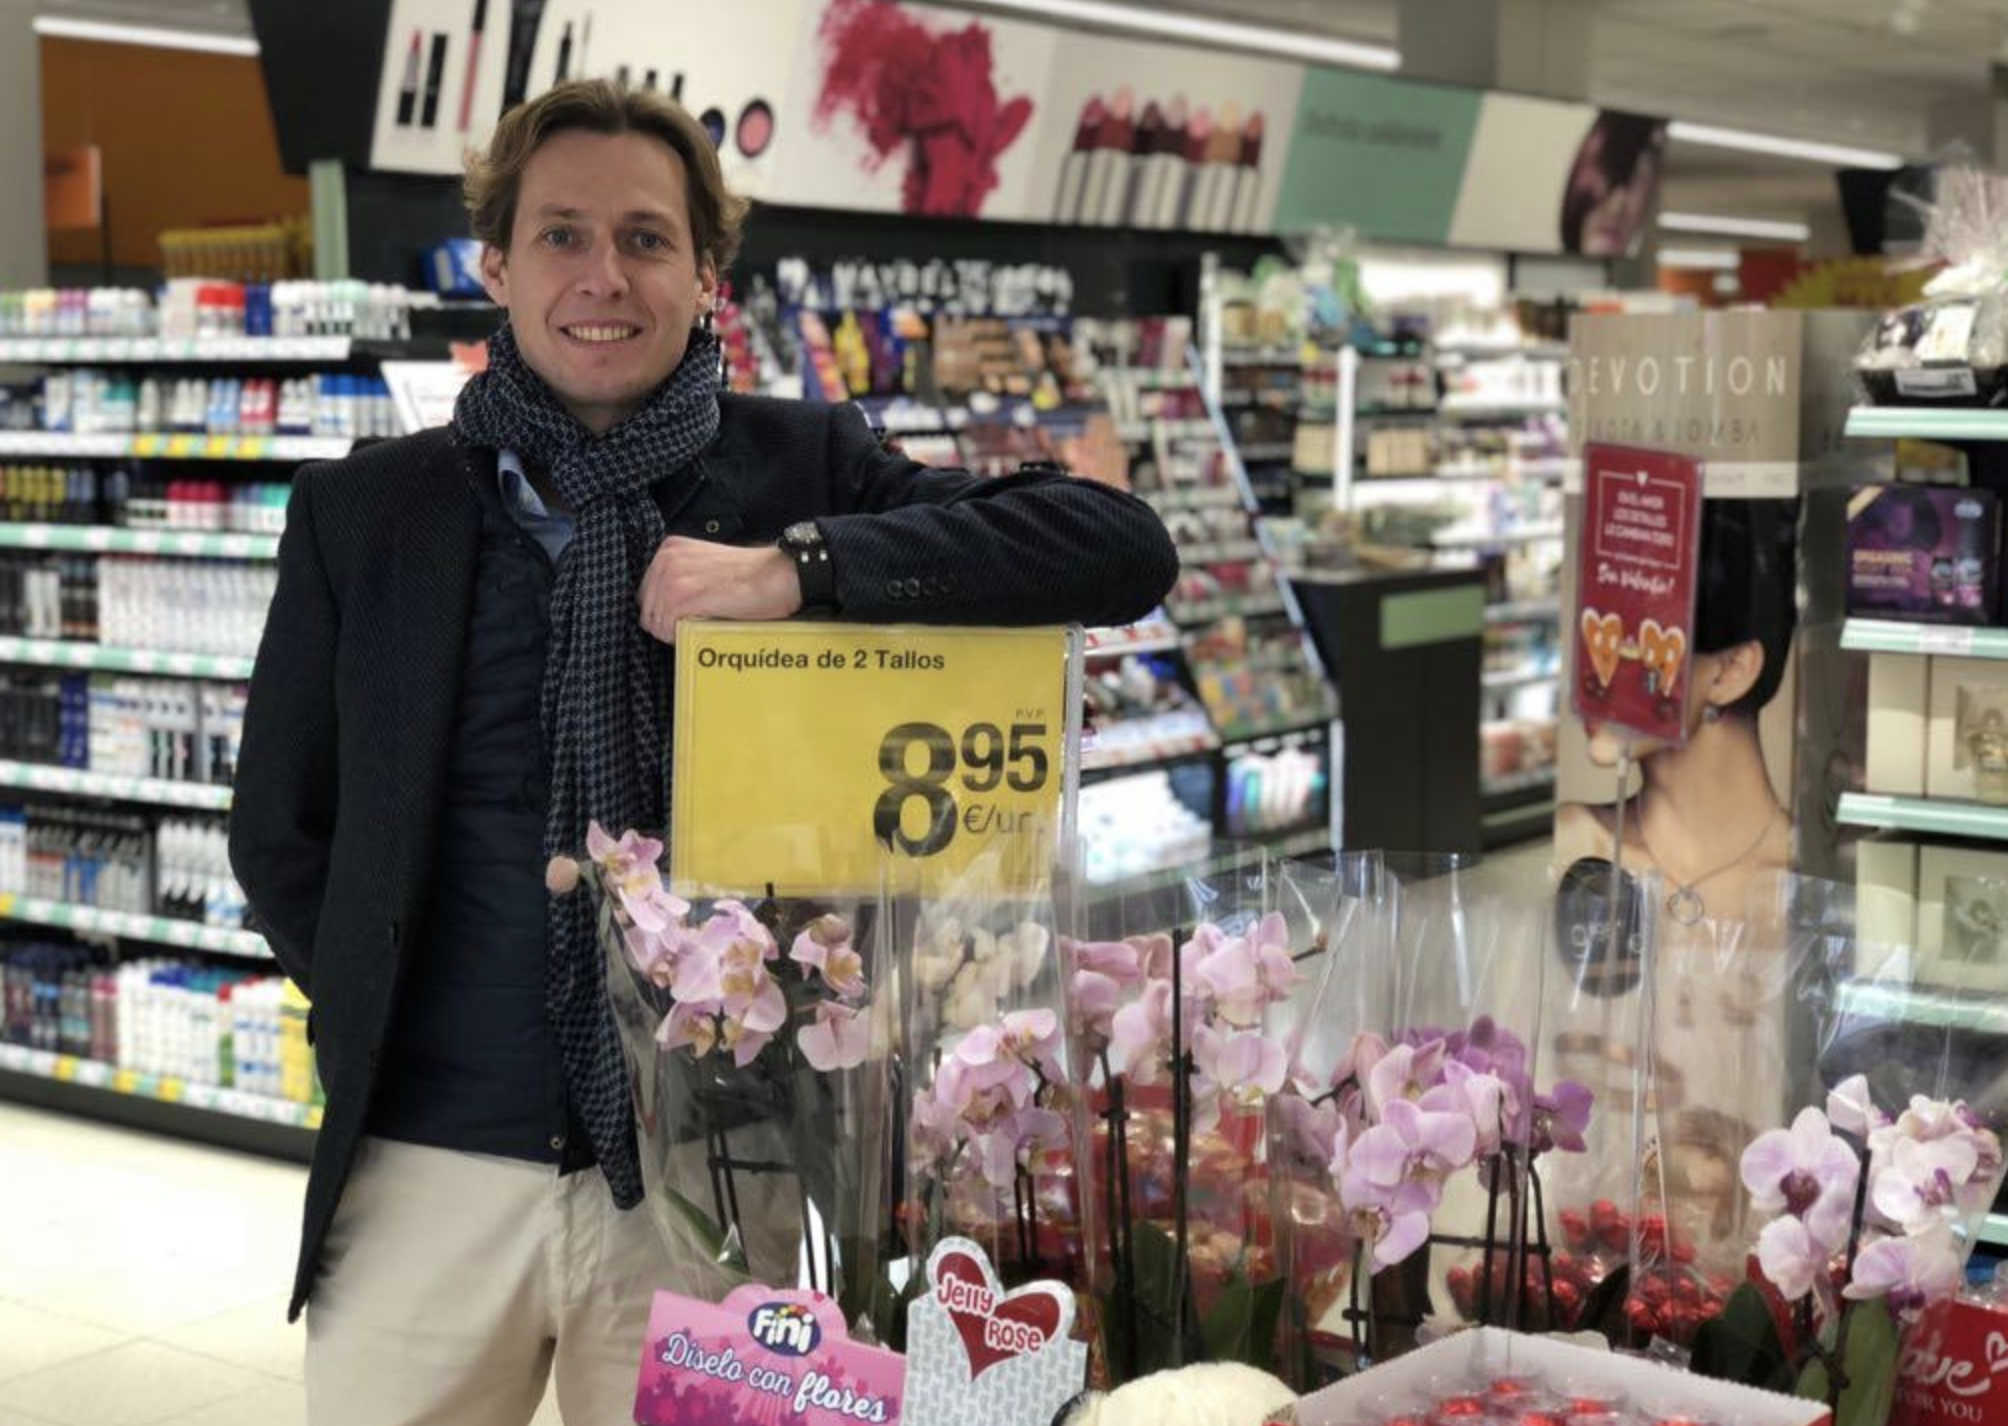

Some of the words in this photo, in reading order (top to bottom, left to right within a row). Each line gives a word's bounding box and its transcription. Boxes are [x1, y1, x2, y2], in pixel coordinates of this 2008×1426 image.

[698, 648, 809, 672] Orquídea
[817, 649, 846, 669] de
[853, 650, 867, 668] 2
[874, 649, 945, 670] Tallos
[937, 1276, 993, 1314] Jelly
[750, 1367, 793, 1396] con
[794, 1371, 887, 1422] flores
[1940, 1397, 1983, 1424] YOU
